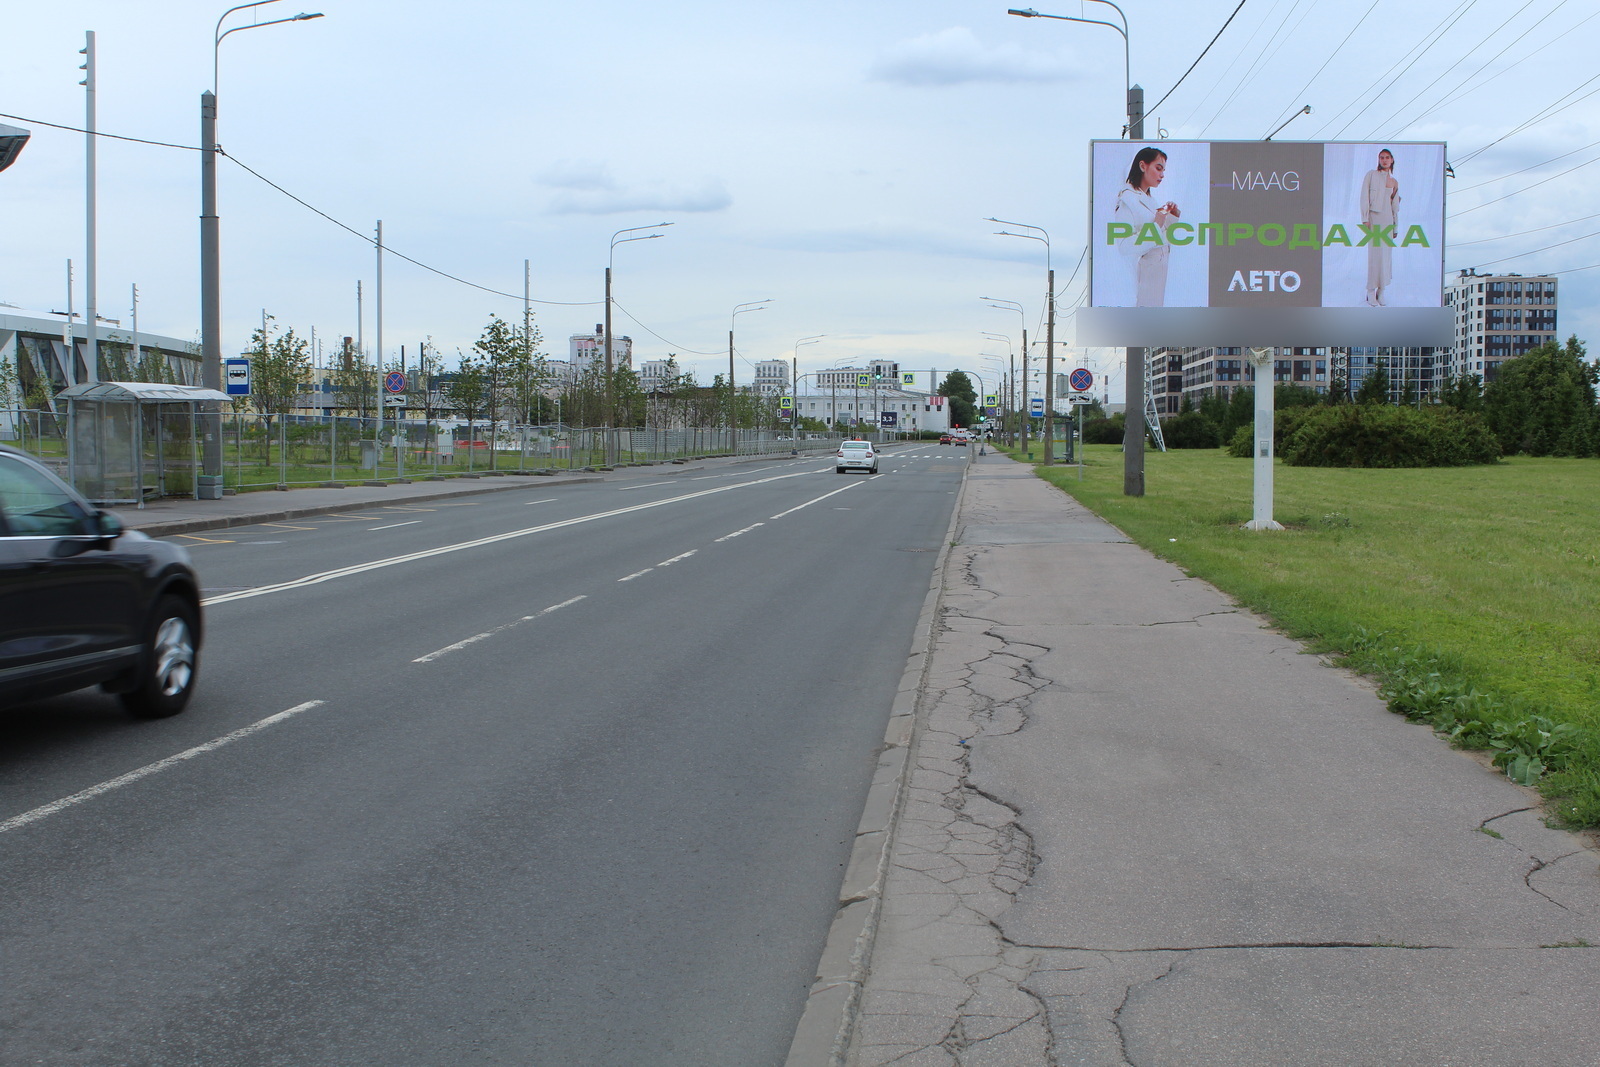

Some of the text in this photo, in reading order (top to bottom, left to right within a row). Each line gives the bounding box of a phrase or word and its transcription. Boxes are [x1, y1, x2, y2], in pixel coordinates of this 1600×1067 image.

[1232, 171, 1300, 191] MAAG
[1107, 222, 1430, 250] РАСПРОДАЖА
[1227, 270, 1301, 292] ЛЕТО
